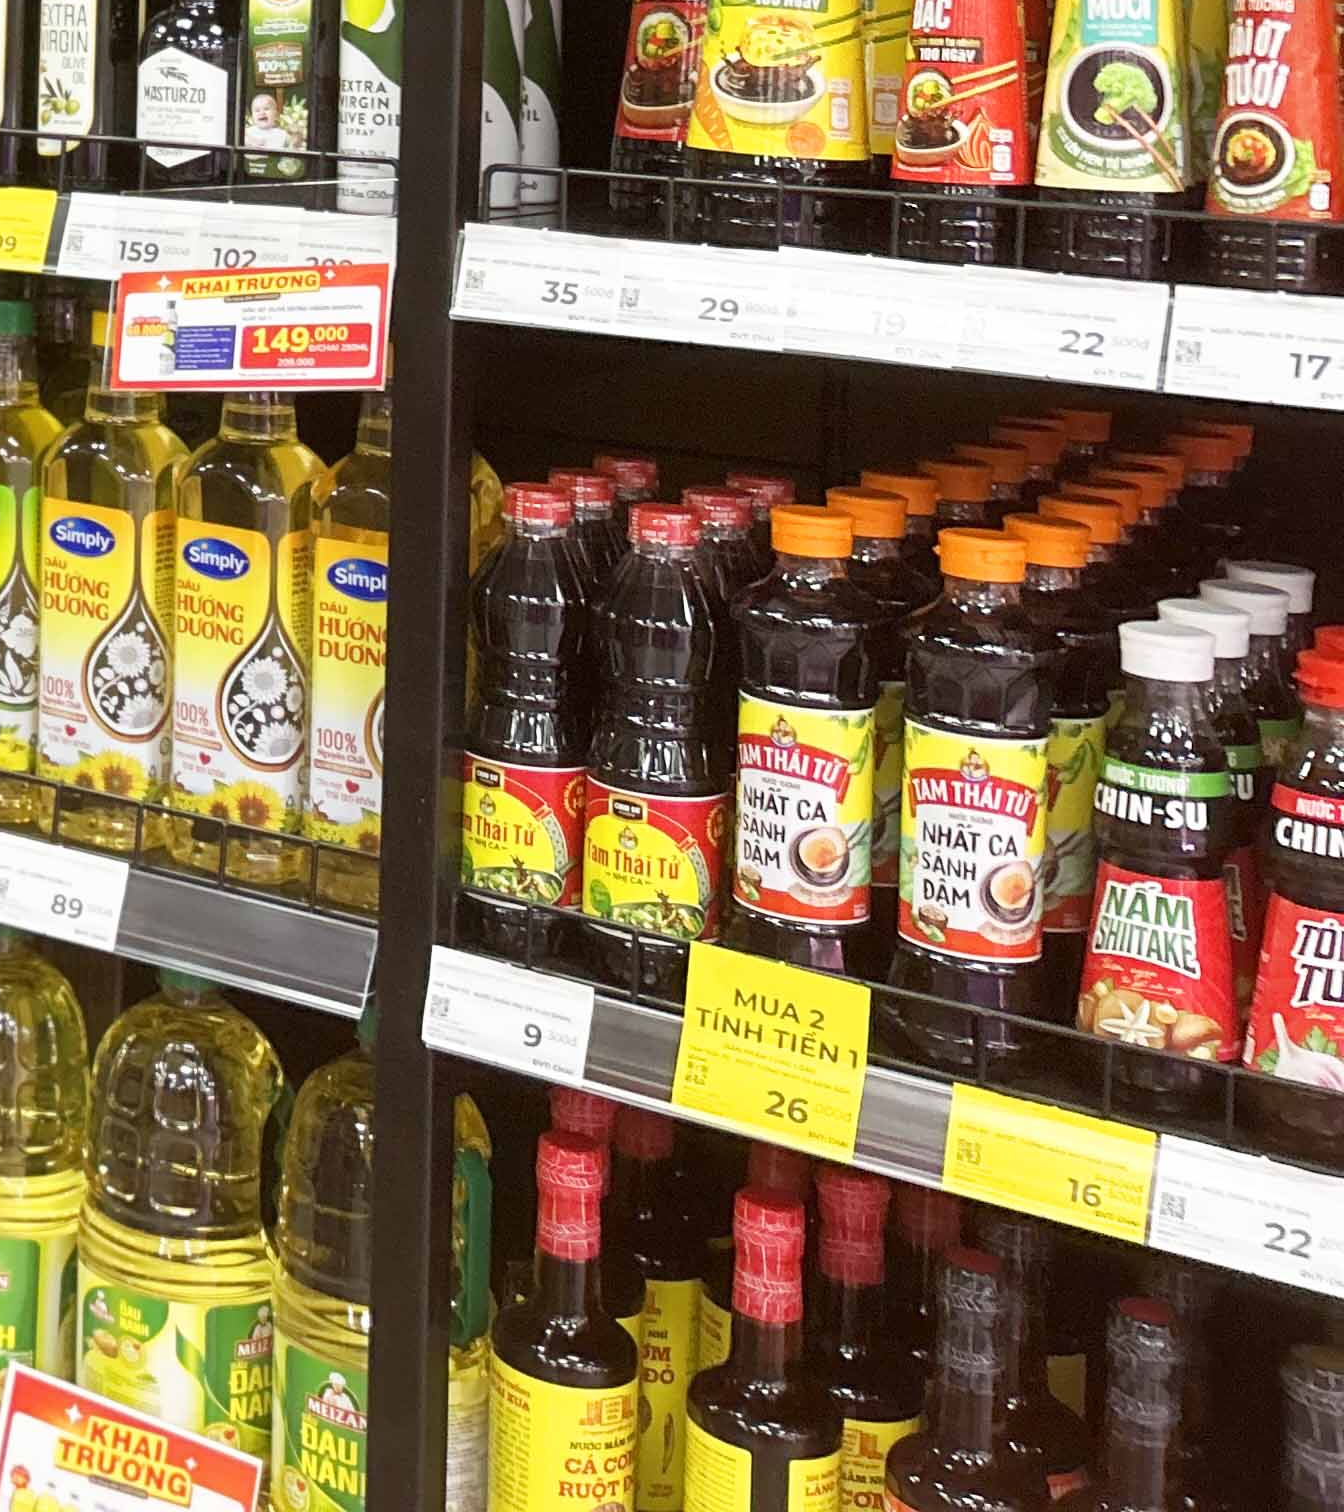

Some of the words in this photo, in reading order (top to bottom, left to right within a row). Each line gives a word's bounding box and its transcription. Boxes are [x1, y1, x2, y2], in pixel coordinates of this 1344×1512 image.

[41, 3, 89, 27] EXTRA
[919, 45, 939, 61] 100
[144, 85, 207, 105] MASTURZO
[340, 80, 388, 95] EXTRA
[118, 239, 160, 264] 159
[212, 246, 257, 270] 102
[183, 278, 231, 296] KHAI
[236, 273, 319, 292] TRƯƠNG
[540, 279, 580, 306] 35
[697, 296, 740, 323] 29
[251, 324, 350, 355] 149.000
[1058, 328, 1106, 357] 22
[1288, 352, 1333, 380] 17
[54, 520, 115, 554] Simply
[186, 541, 250, 576] Simply
[43, 568, 111, 600] HƯỚNG
[333, 561, 388, 592] Simpl
[43, 592, 110, 622] DƯƠNG
[176, 591, 245, 623] HƯỚNG
[176, 615, 244, 647] DƯƠNG
[175, 701, 210, 728] 100%
[316, 726, 358, 755] 100%
[763, 744, 810, 776] THÁI
[741, 785, 791, 817] NHẤT
[796, 797, 828, 824] CA
[912, 776, 950, 804] TAM
[952, 779, 1002, 811] THÁI
[1095, 782, 1209, 833] CHIN-SU
[475, 816, 508, 843] Thái
[920, 816, 982, 854] NHẤT
[987, 832, 1019, 859] CA
[585, 838, 611, 867] Tam
[613, 848, 653, 877] Thái
[656, 854, 683, 882] Tử
[49, 892, 85, 920] 89
[1102, 881, 1193, 931] NẤM
[1092, 923, 1200, 976] SHIITAKE
[733, 989, 800, 1026] MUA
[809, 1009, 826, 1031] 2
[522, 1023, 543, 1048] 9
[697, 1006, 765, 1044] TÍNH
[774, 1025, 839, 1064] TIỀN
[850, 1049, 859, 1070] 1
[764, 1089, 810, 1125] 26
[1067, 1177, 1103, 1209] 16
[1263, 1221, 1313, 1259] 22
[90, 1416, 168, 1463] KHAI
[56, 1437, 189, 1500] TRƯƠNG
[301, 1448, 368, 1495] NÀN
[563, 1452, 598, 1475] CÁ
